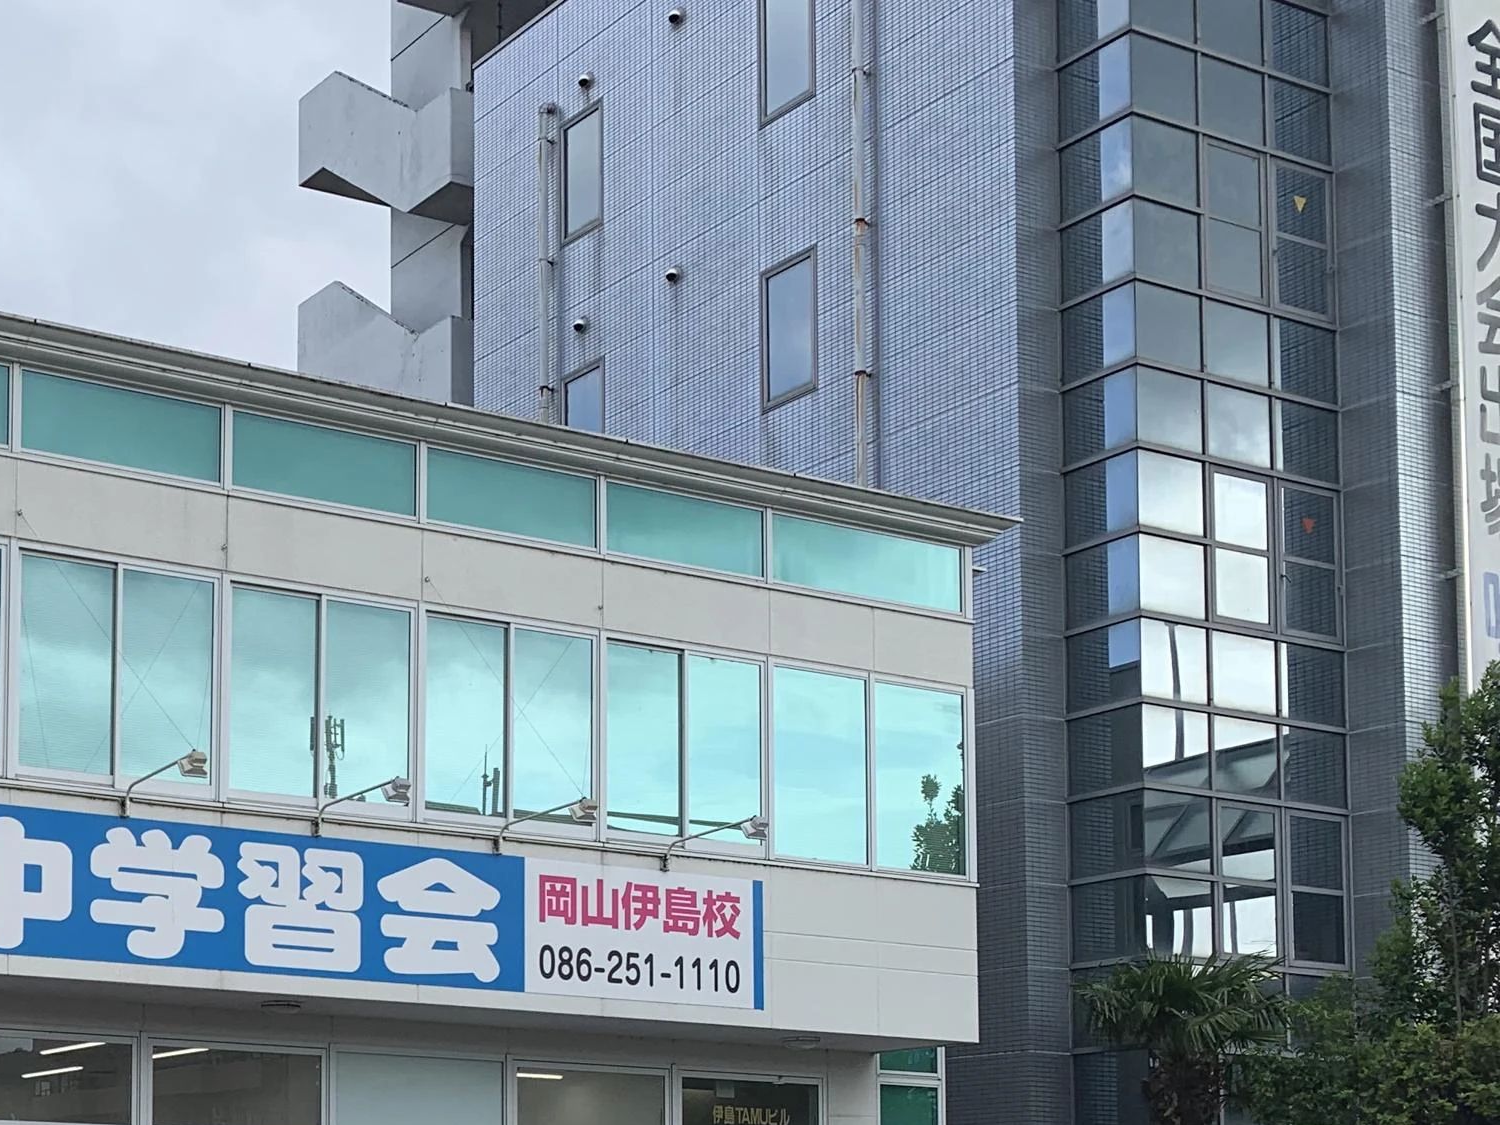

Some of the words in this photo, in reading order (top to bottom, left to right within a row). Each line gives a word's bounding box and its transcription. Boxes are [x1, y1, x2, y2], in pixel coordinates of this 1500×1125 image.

[539, 874, 741, 940] 岡山伊島校
[539, 944, 741, 994] 086-251-1110
